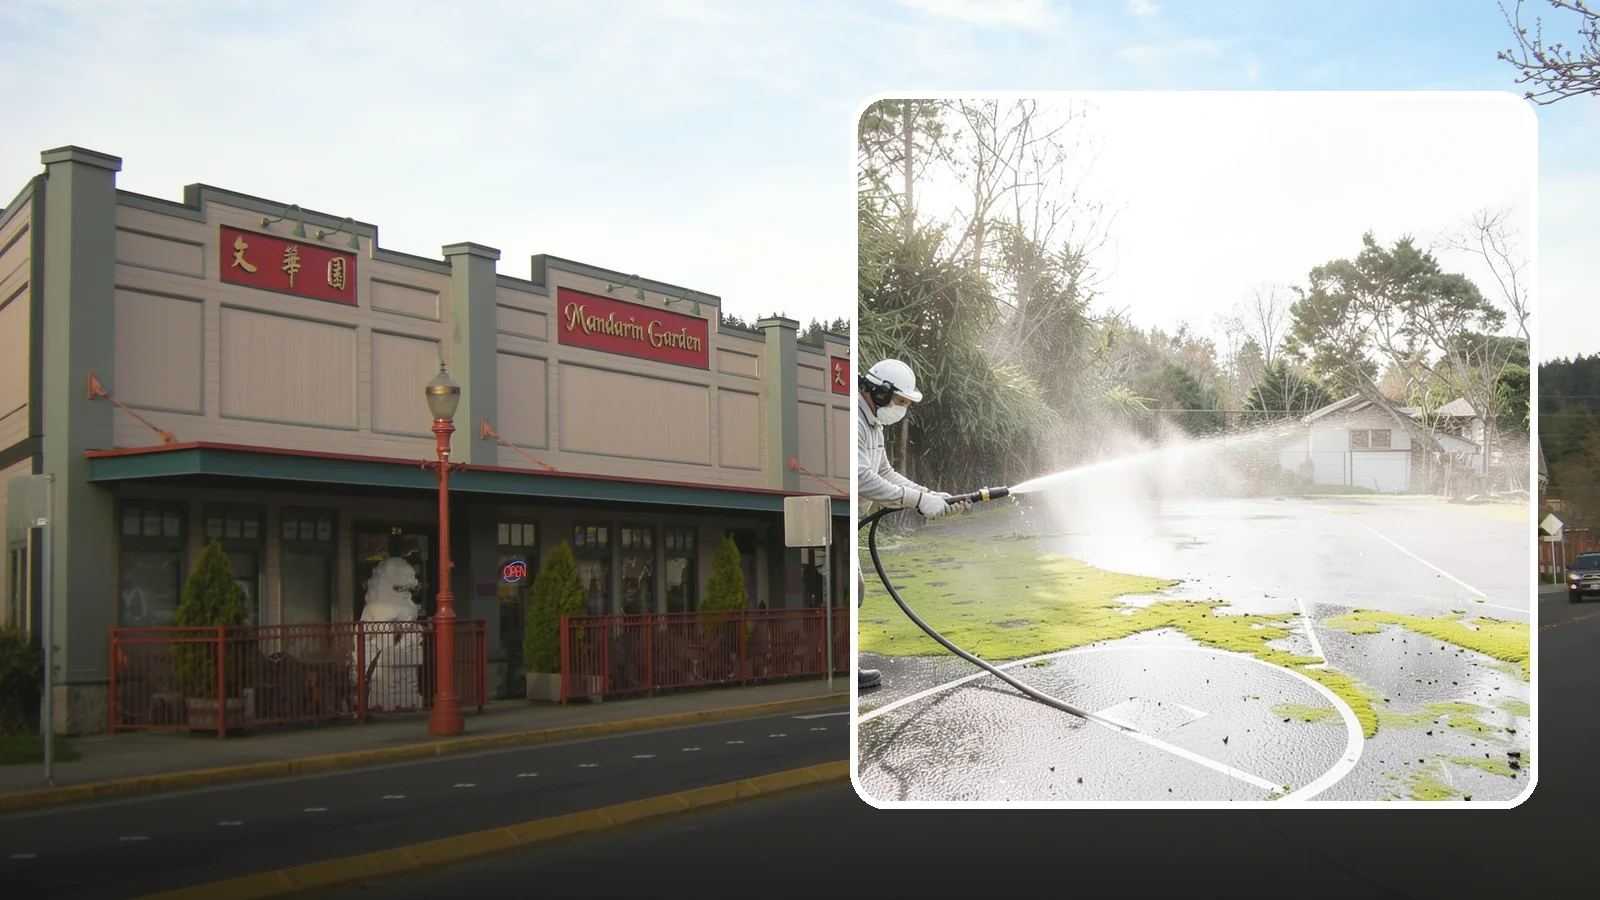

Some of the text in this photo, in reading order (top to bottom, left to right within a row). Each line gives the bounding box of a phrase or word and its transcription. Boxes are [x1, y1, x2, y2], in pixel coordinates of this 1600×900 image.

[231, 236, 346, 290] 文華園
[565, 302, 701, 352] Mandarin Garden
[503, 565, 526, 578] OPEN
